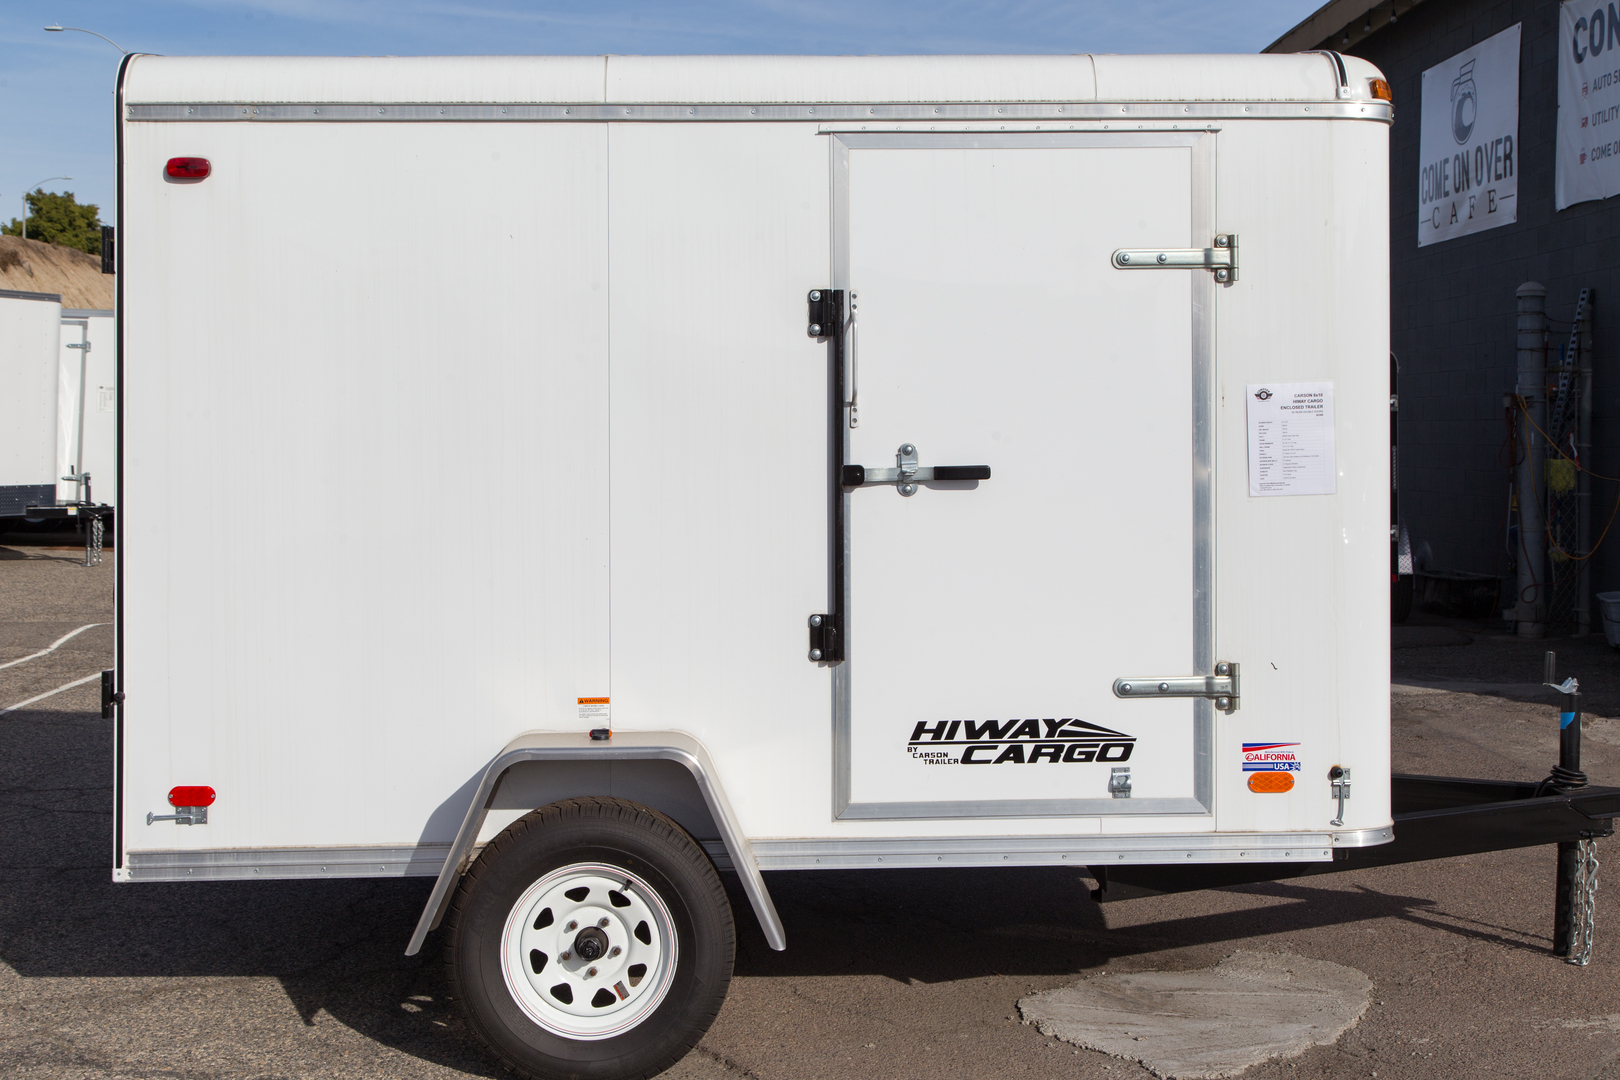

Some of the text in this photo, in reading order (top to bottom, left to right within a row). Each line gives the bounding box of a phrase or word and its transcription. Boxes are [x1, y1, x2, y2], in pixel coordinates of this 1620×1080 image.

[1592, 72, 1612, 93] AUTO
[1591, 104, 1620, 127] UTILITY
[1591, 142, 1612, 162] COME
[1421, 134, 1513, 205] COME ON OVER
[1432, 188, 1498, 230] CAFE
[909, 718, 1074, 741] HIWAY
[960, 742, 1135, 765] CARGO
